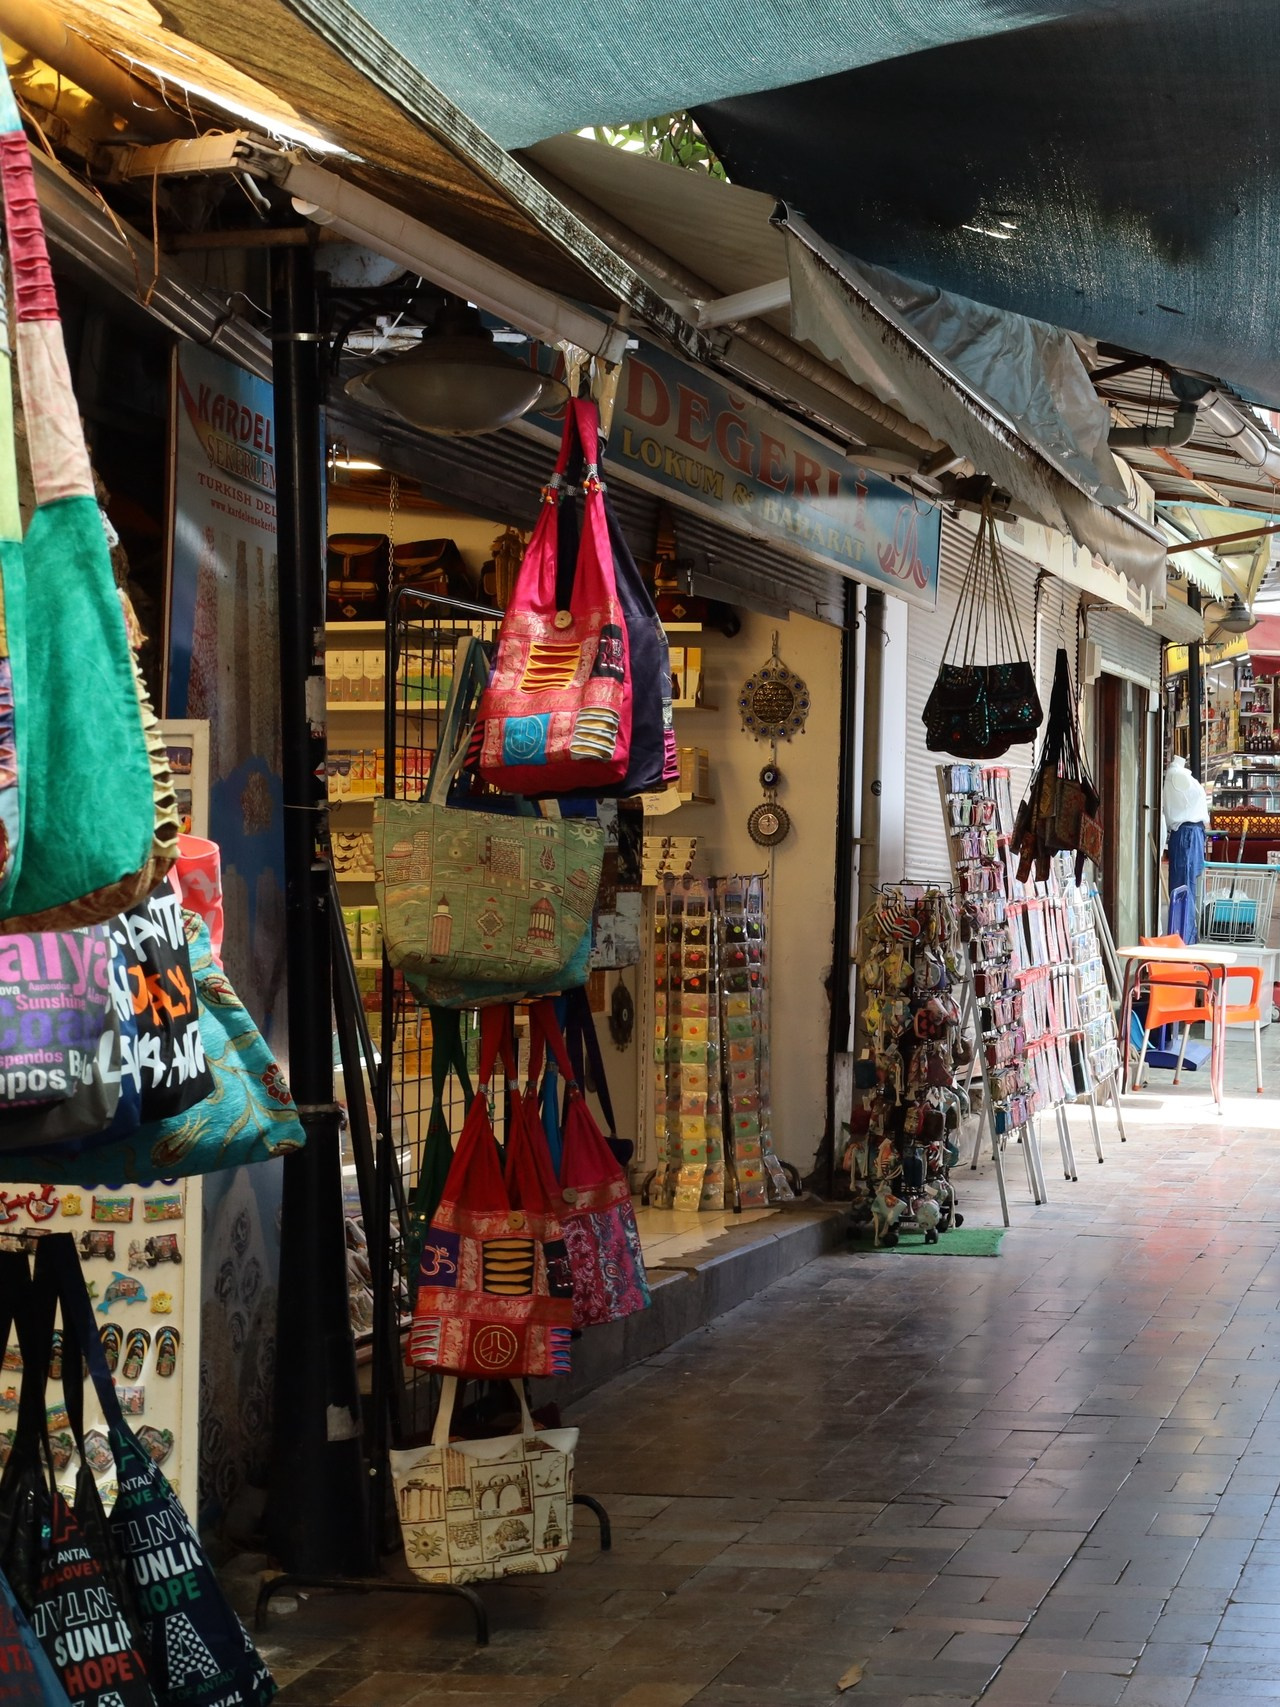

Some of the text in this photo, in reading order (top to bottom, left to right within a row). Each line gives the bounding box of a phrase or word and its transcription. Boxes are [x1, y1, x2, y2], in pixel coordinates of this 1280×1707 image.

[198, 383, 274, 457] KARDEL
[206, 433, 276, 491] ŞEKERLEM
[197, 472, 277, 518] TURKISH DEL
[210, 498, 277, 535] www.kardelensekerle
[622, 425, 867, 562] LOKUM & BAHARAT
[0, 931, 108, 996] alya
[0, 1048, 64, 1070] spendos
[64, 1651, 134, 1697] HOPE
